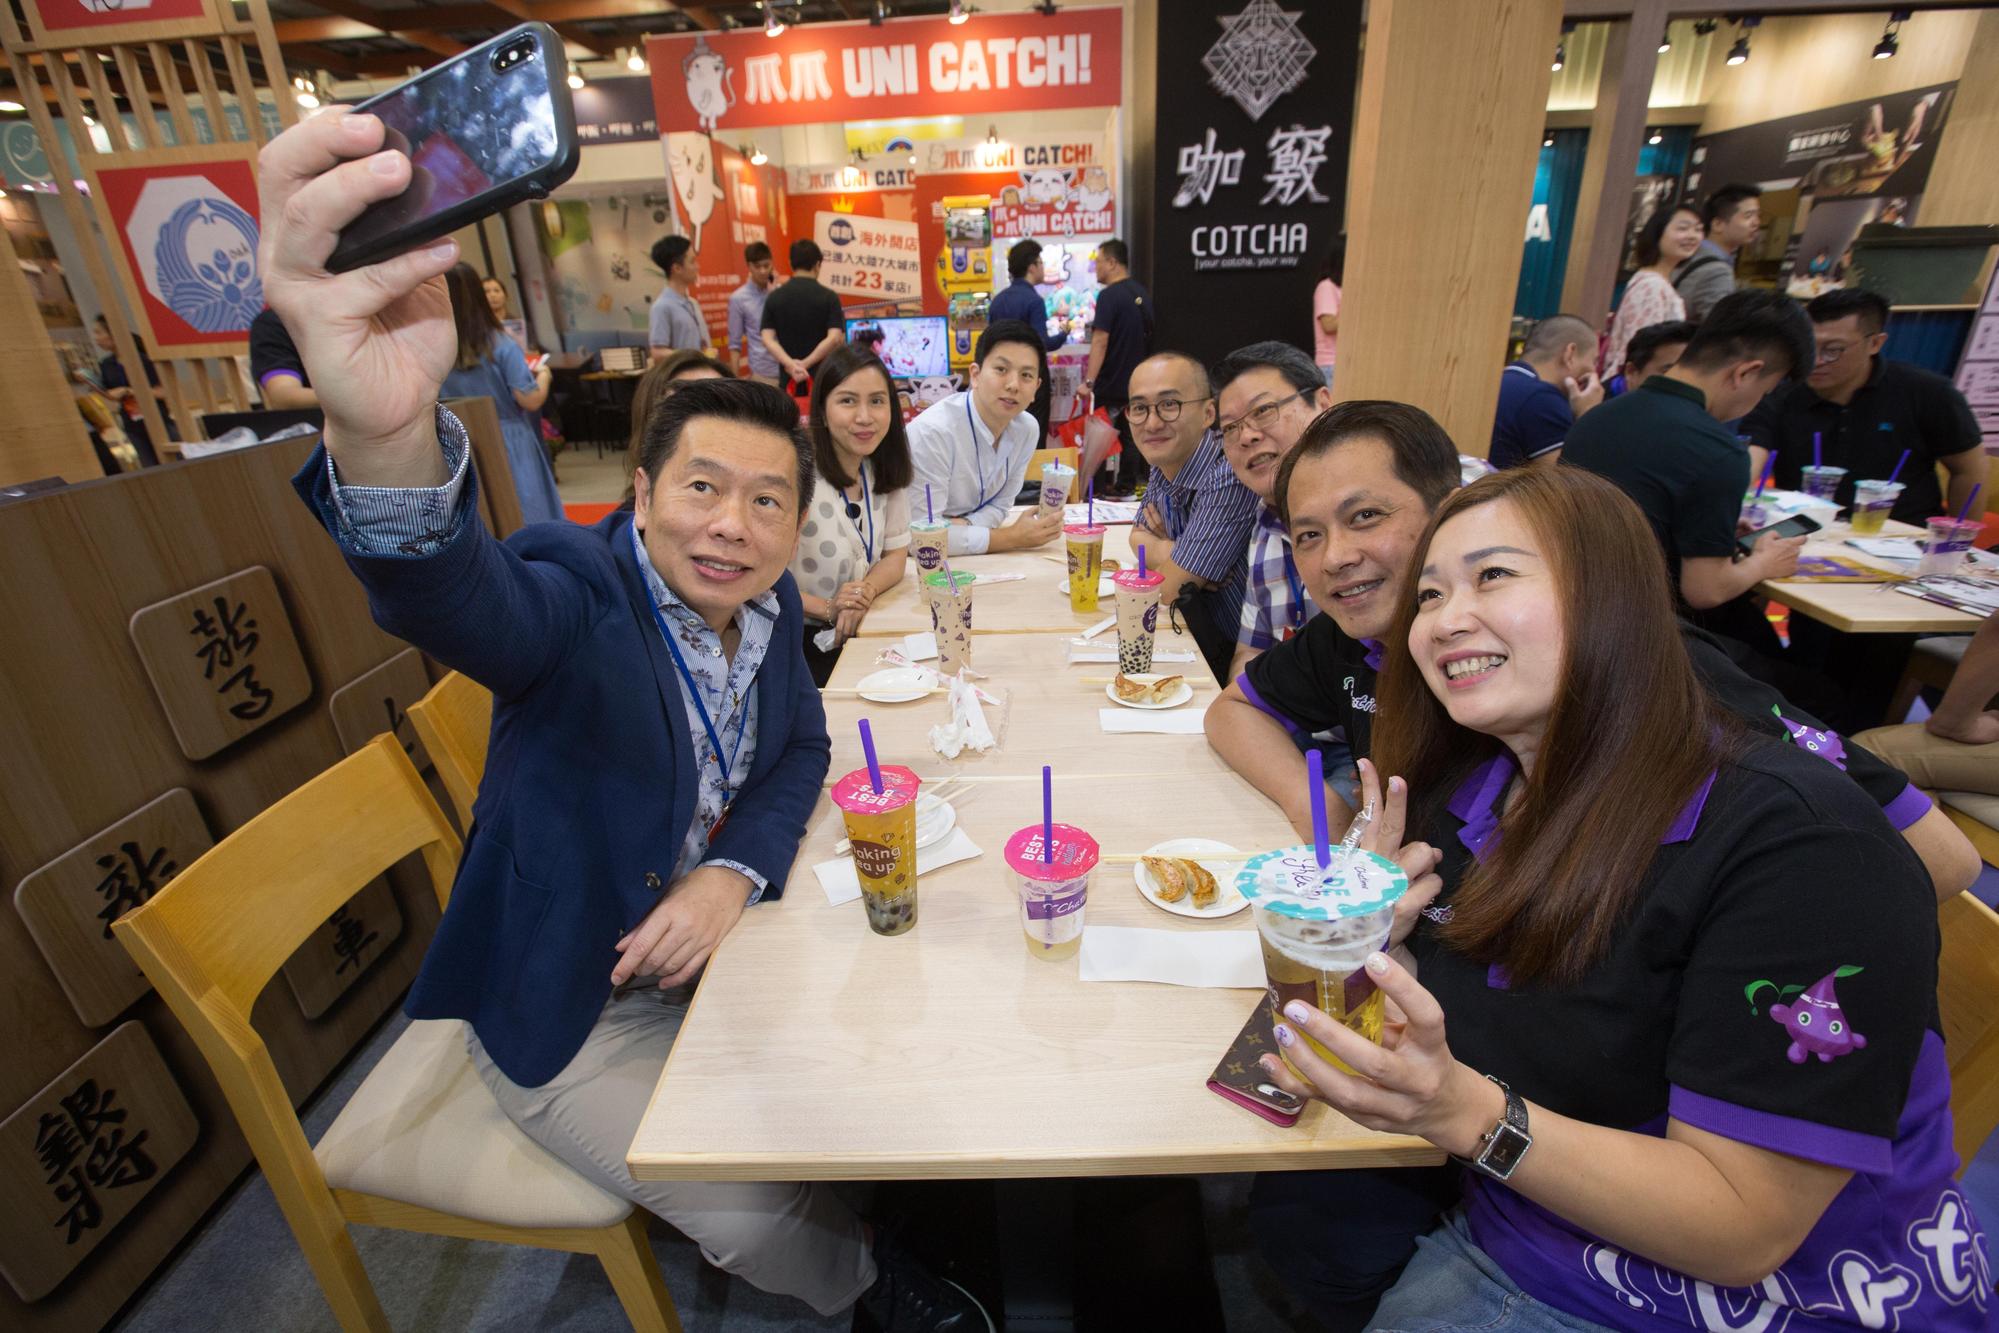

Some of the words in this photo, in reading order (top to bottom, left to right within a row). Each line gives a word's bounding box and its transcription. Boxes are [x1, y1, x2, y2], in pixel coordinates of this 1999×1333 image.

[841, 44, 919, 97] UNI
[928, 33, 1092, 93] CATCH!
[1024, 143, 1093, 166] CATCH!
[1018, 212, 1047, 233] UNI
[1050, 210, 1112, 233] CATCH!
[859, 231, 918, 251] 海外開店
[1191, 222, 1308, 256] COTCHA
[848, 791, 888, 806] BEST
[1021, 834, 1045, 861] BEST
[877, 862, 896, 874] up
